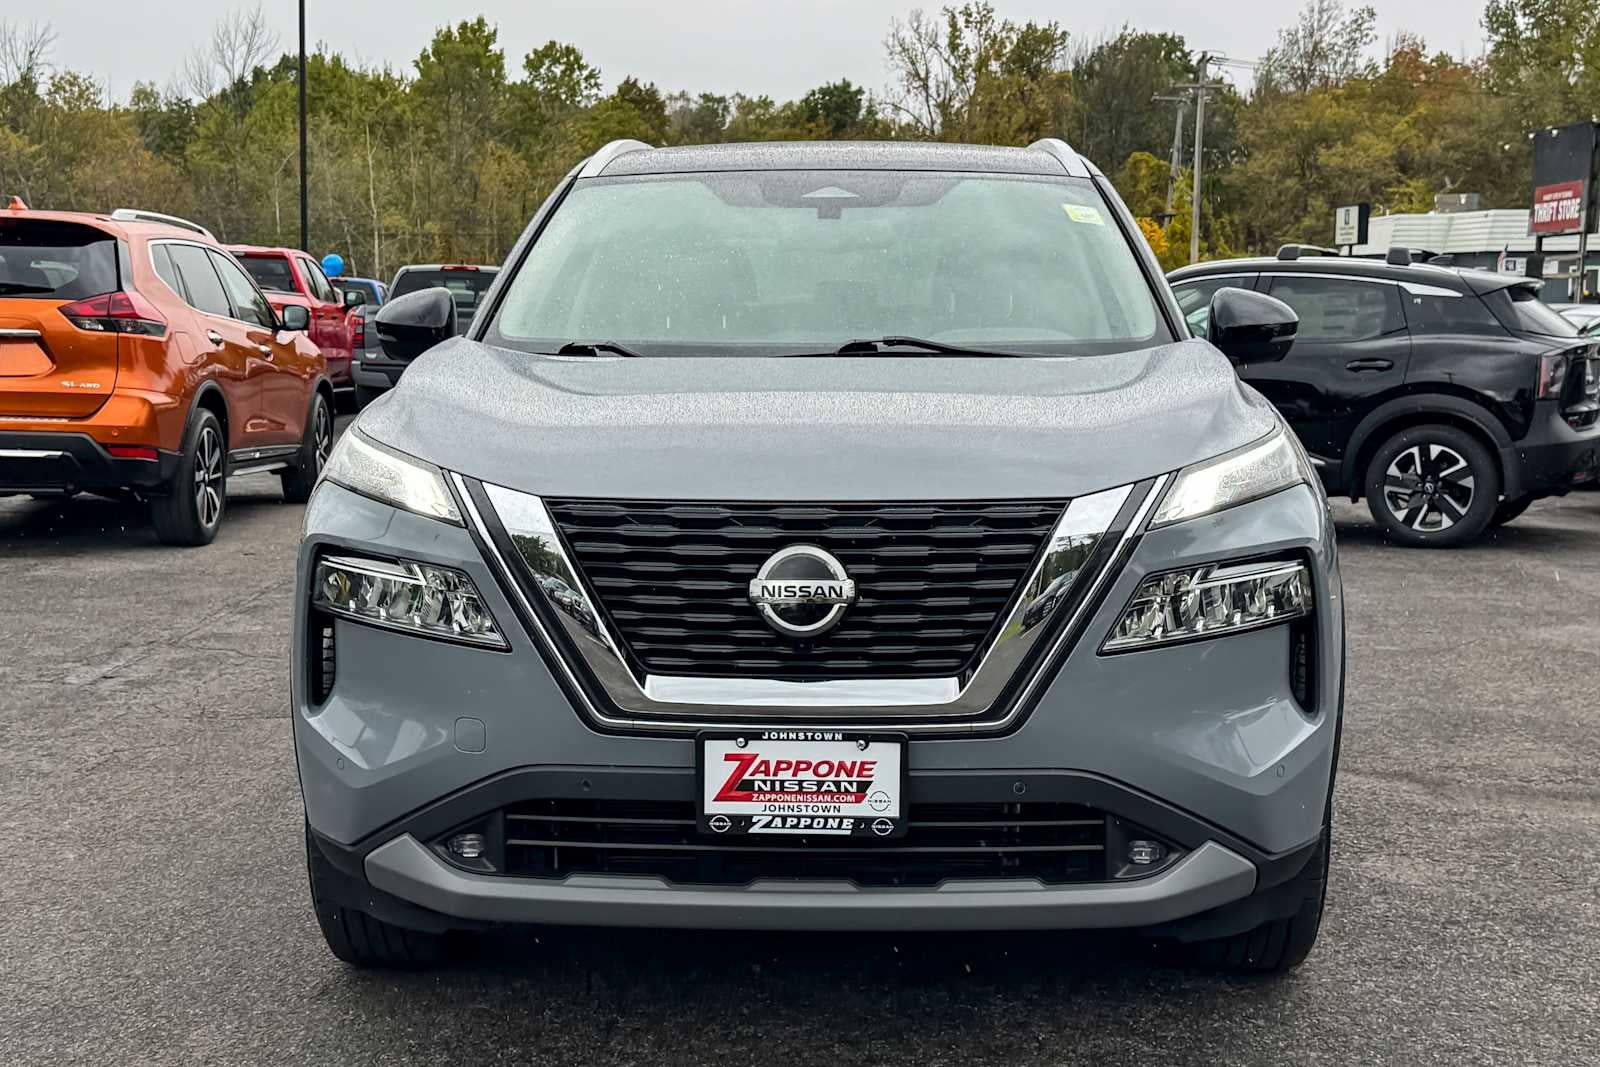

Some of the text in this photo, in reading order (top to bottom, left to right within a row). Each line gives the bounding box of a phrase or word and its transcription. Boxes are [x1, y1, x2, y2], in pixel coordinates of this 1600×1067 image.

[1534, 198, 1581, 223] THRIFT STORE
[761, 585, 843, 598] NISSAN
[762, 731, 843, 741] JOHNSTOWN
[712, 753, 878, 802] ZAPPONE
[753, 780, 858, 792] NISSAN
[751, 793, 856, 803] ZAPPONENISSAN.COM
[761, 804, 842, 814] JOHNSTOWN
[748, 815, 855, 834] ZAPPONE
